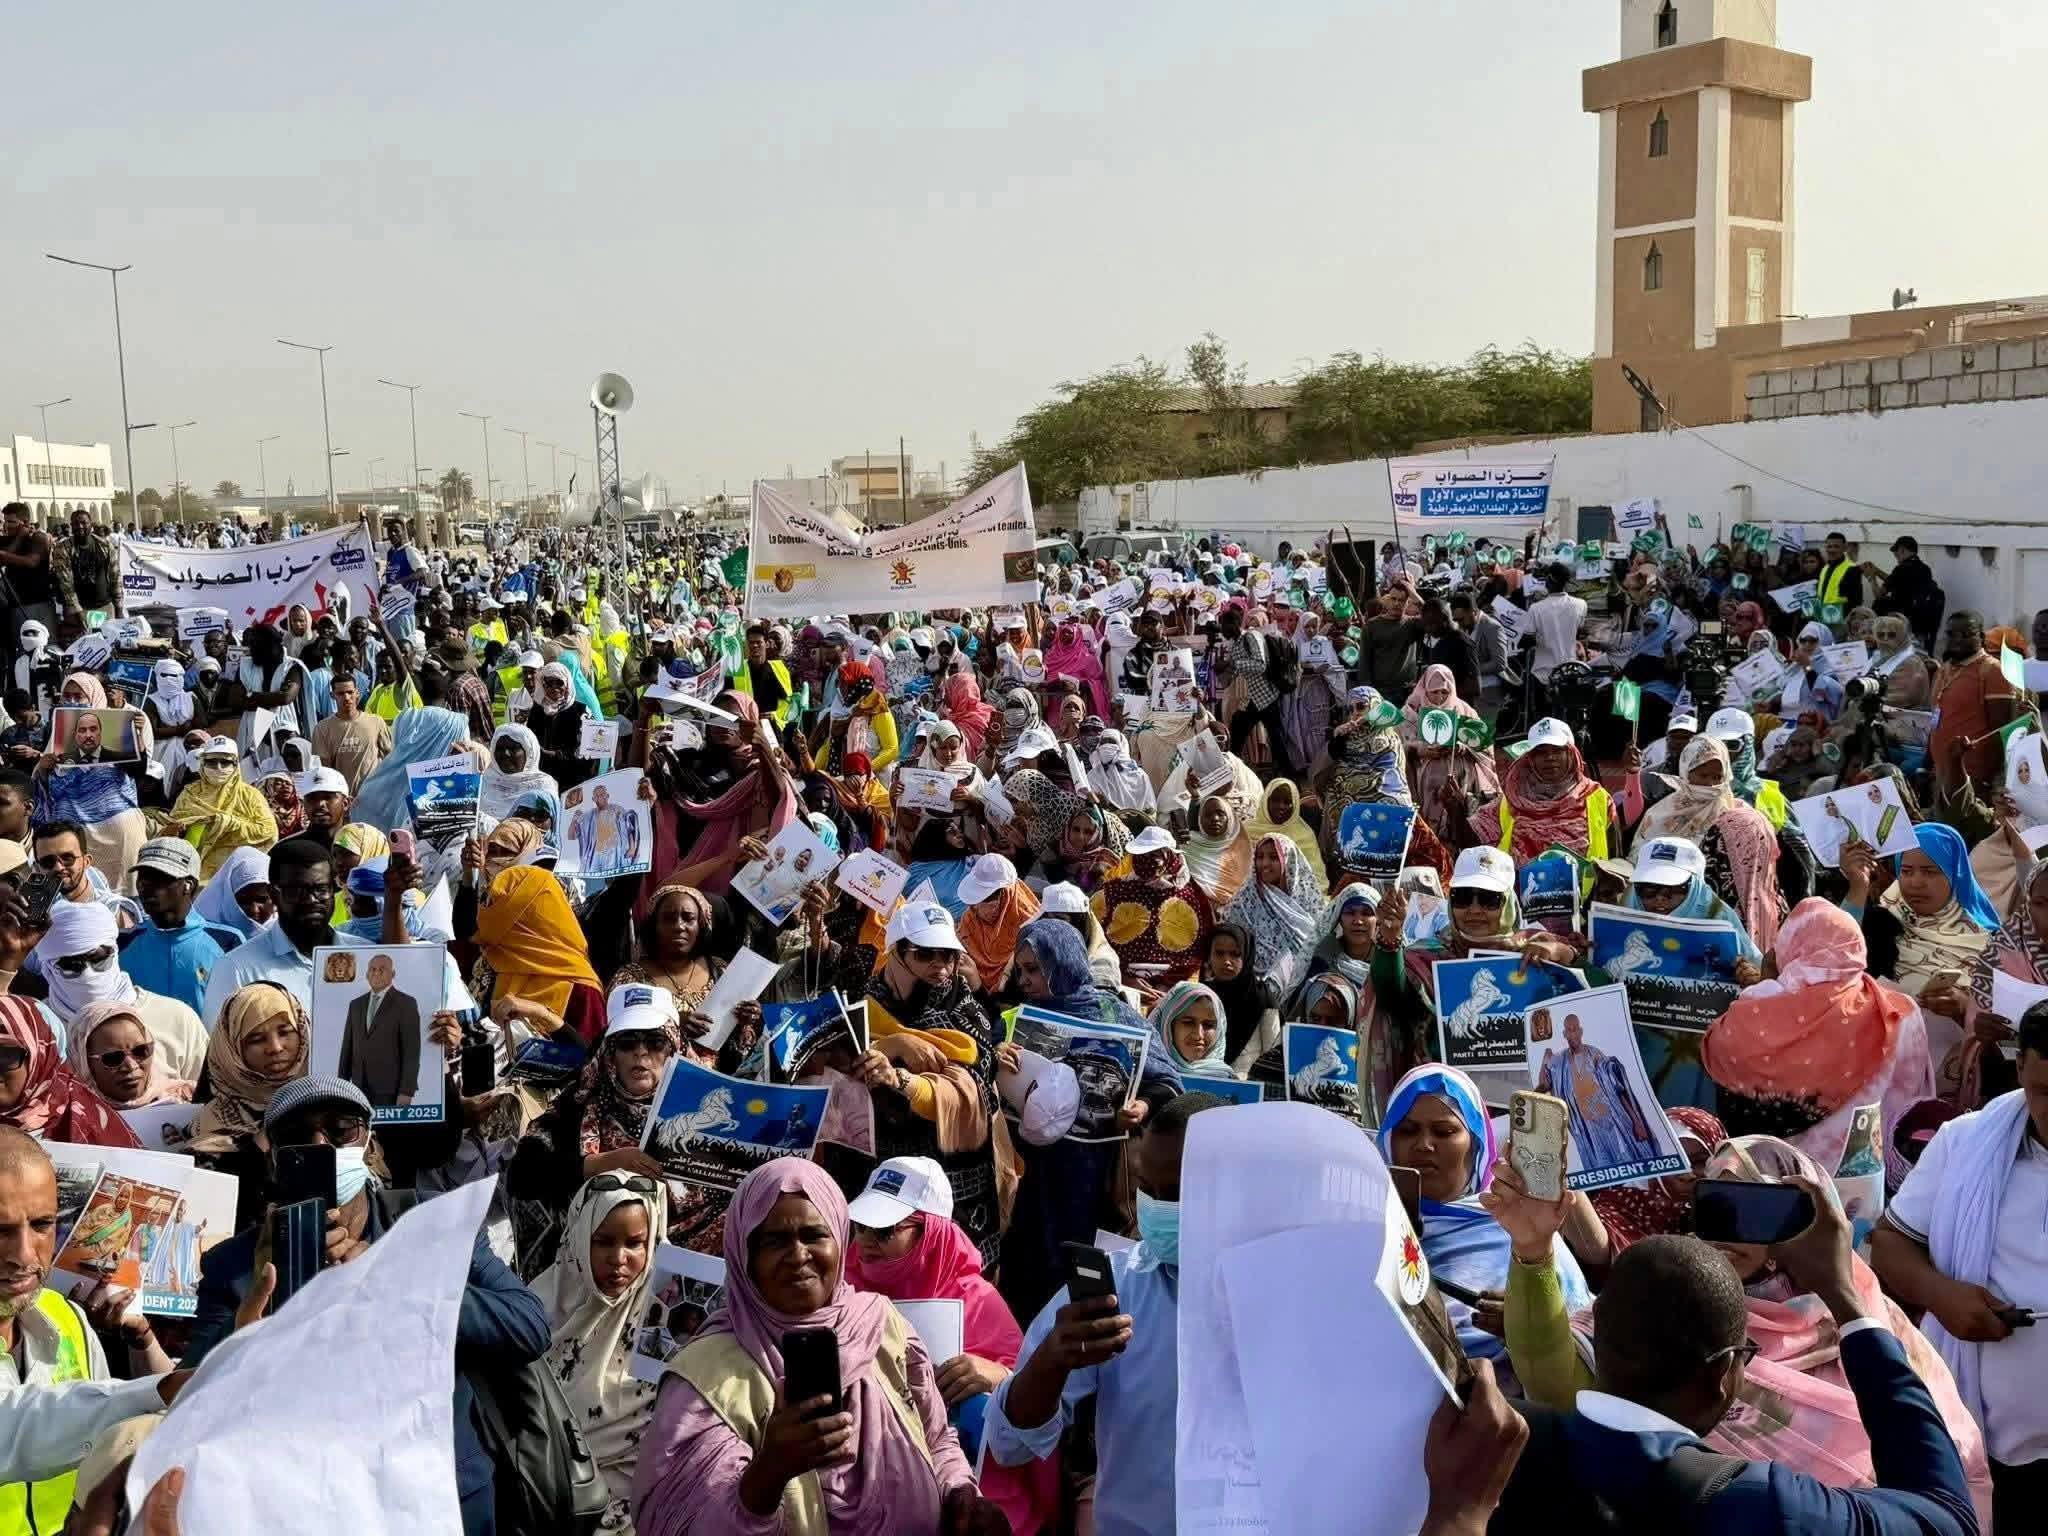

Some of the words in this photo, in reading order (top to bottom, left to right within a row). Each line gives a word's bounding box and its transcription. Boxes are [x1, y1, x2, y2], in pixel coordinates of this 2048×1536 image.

[1435, 470, 1491, 485] الصواب
[1495, 469, 1547, 484] حزب
[1456, 488, 1494, 502] الحارس
[124, 577, 154, 588] الصواب
[167, 563, 261, 591] الصواب
[1489, 1049, 1526, 1057] L'ALLIANC
[407, 1107, 439, 1118] 2029
[1648, 1157, 1681, 1172] 2029
